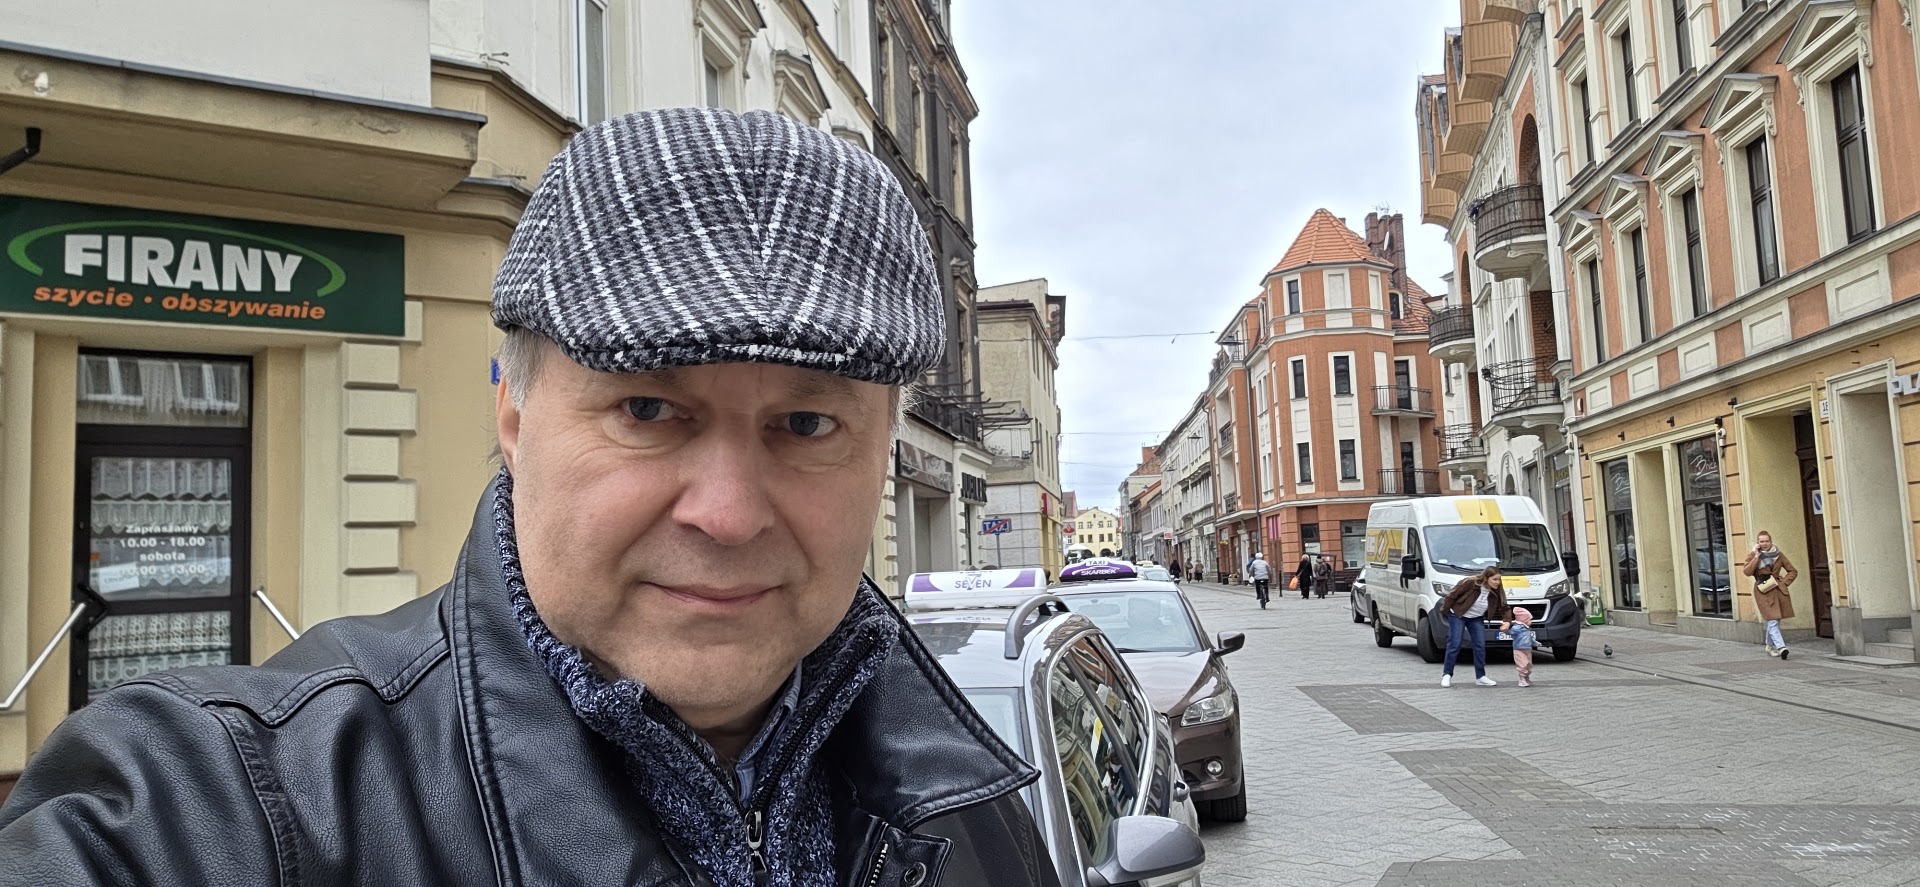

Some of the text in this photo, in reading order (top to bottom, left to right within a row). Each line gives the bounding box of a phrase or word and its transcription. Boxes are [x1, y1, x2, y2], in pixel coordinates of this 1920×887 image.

[65, 234, 302, 292] FIRANY
[34, 286, 326, 320] szycie obszywanie
[125, 525, 199, 535] Zapraszamy
[983, 520, 1009, 533] TAXI
[119, 537, 157, 548] 10.00
[170, 537, 205, 547] 18.00
[139, 551, 186, 561] sobota
[1081, 568, 1117, 576] SKARBEK
[954, 577, 992, 590] SEVEN
